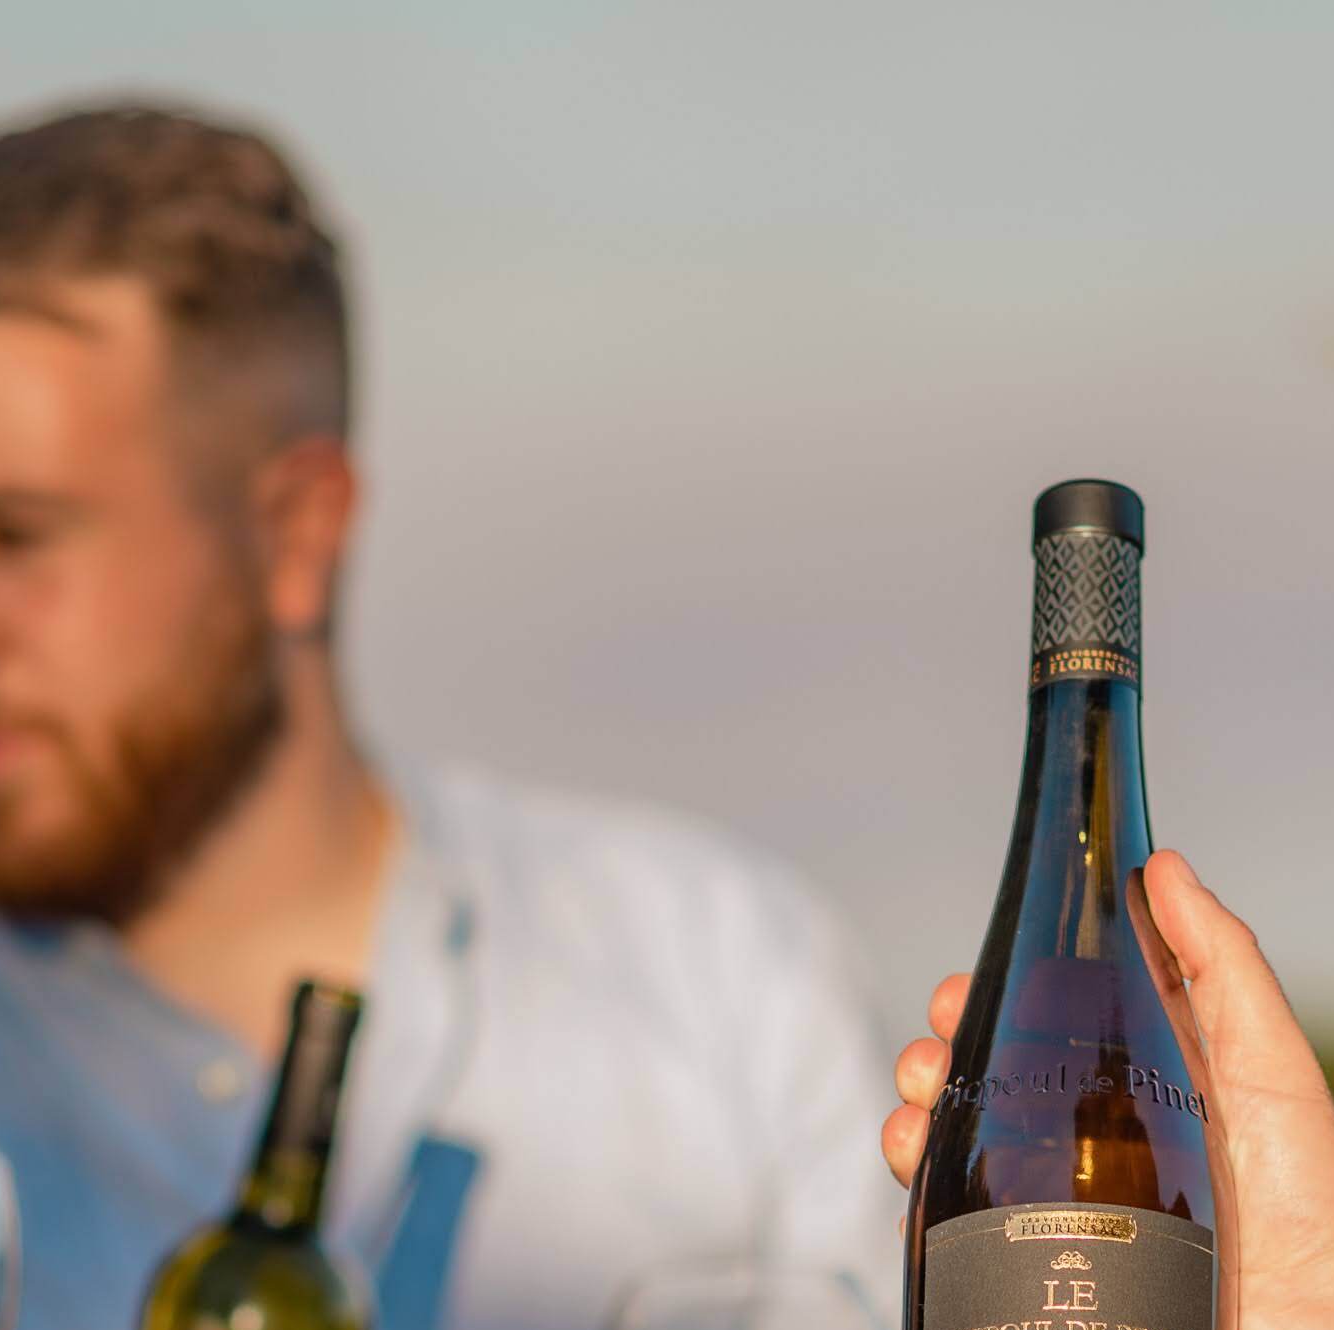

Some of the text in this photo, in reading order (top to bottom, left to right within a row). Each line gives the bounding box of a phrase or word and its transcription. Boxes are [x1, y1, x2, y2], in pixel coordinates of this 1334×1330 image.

[1050, 658, 1138, 683] FLORENSAC
[1076, 1066, 1114, 1094] de
[1124, 1065, 1212, 1124] Pinet
[1022, 1223, 1120, 1238] FLORENSAC
[1042, 1281, 1099, 1311] LE
